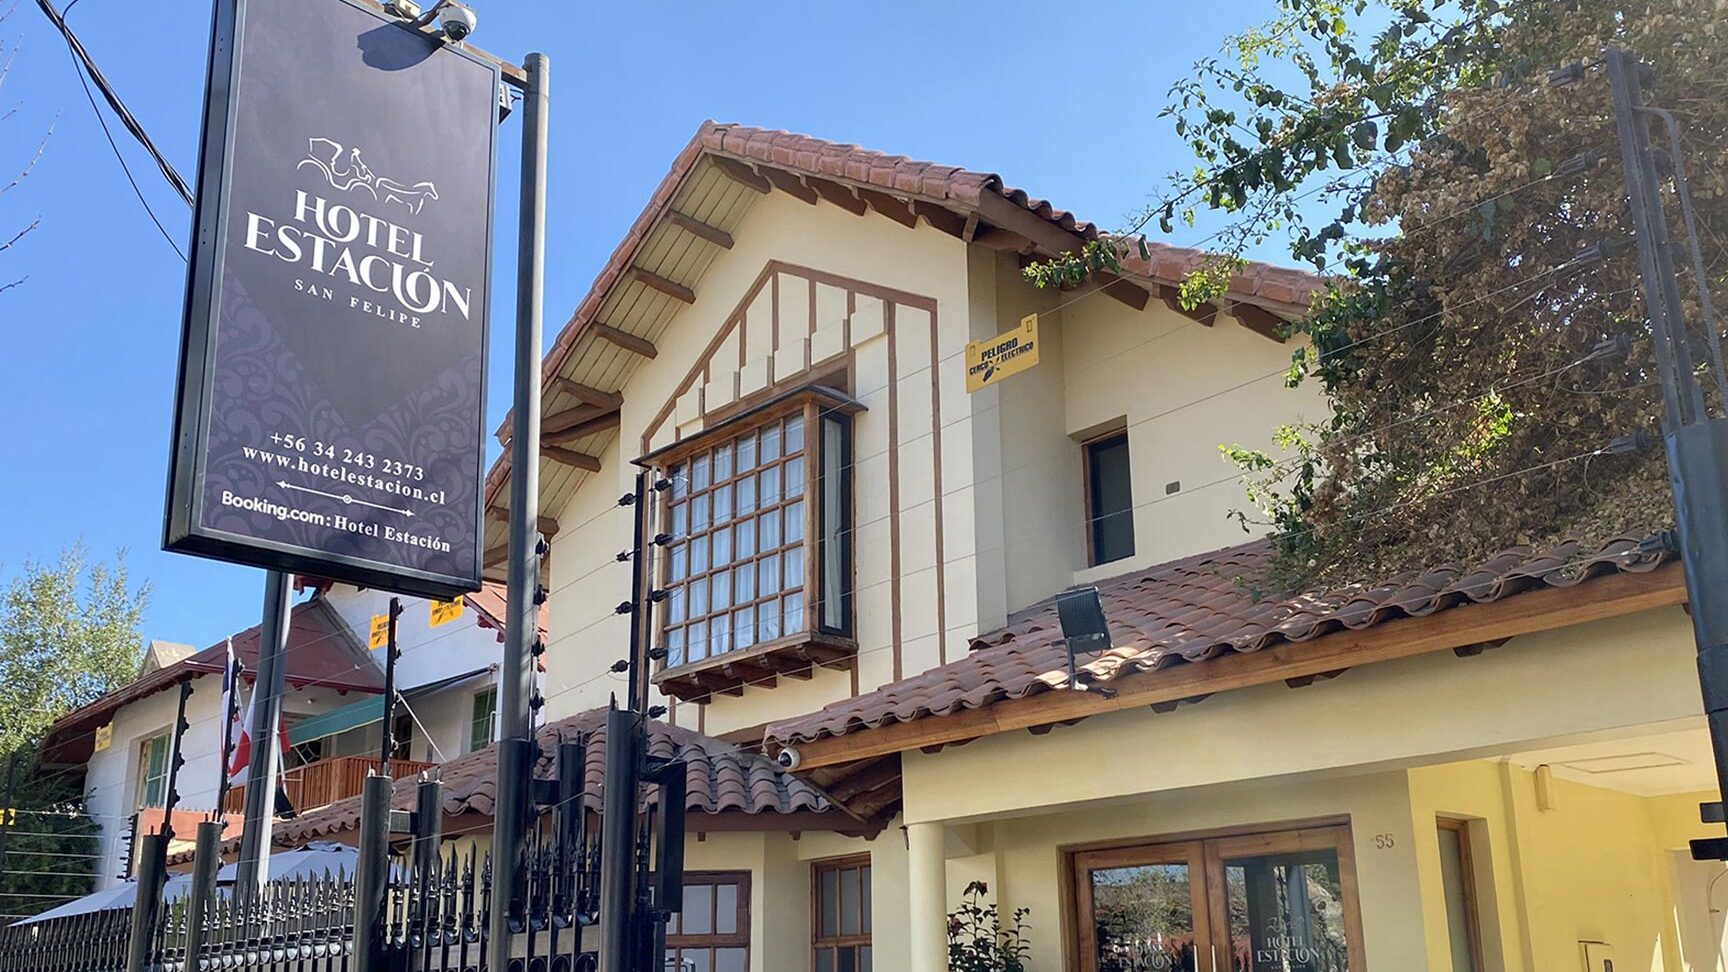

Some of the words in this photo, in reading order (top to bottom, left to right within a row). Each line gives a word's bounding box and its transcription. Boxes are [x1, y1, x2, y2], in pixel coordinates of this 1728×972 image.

[293, 189, 435, 267] HOTEL
[243, 211, 472, 320] ESTACIÓN
[294, 278, 334, 300] SAN
[349, 296, 422, 329] FELIPE
[981, 337, 1018, 361] PELIGRO
[242, 446, 446, 505] www.hotelestacion.cl
[270, 431, 306, 452] +56
[312, 441, 335, 459] 34
[343, 449, 375, 469] 243
[382, 458, 425, 481] 2373
[333, 514, 378, 538] Hotel
[383, 526, 451, 553] Estación
[1375, 832, 1395, 850] 55
